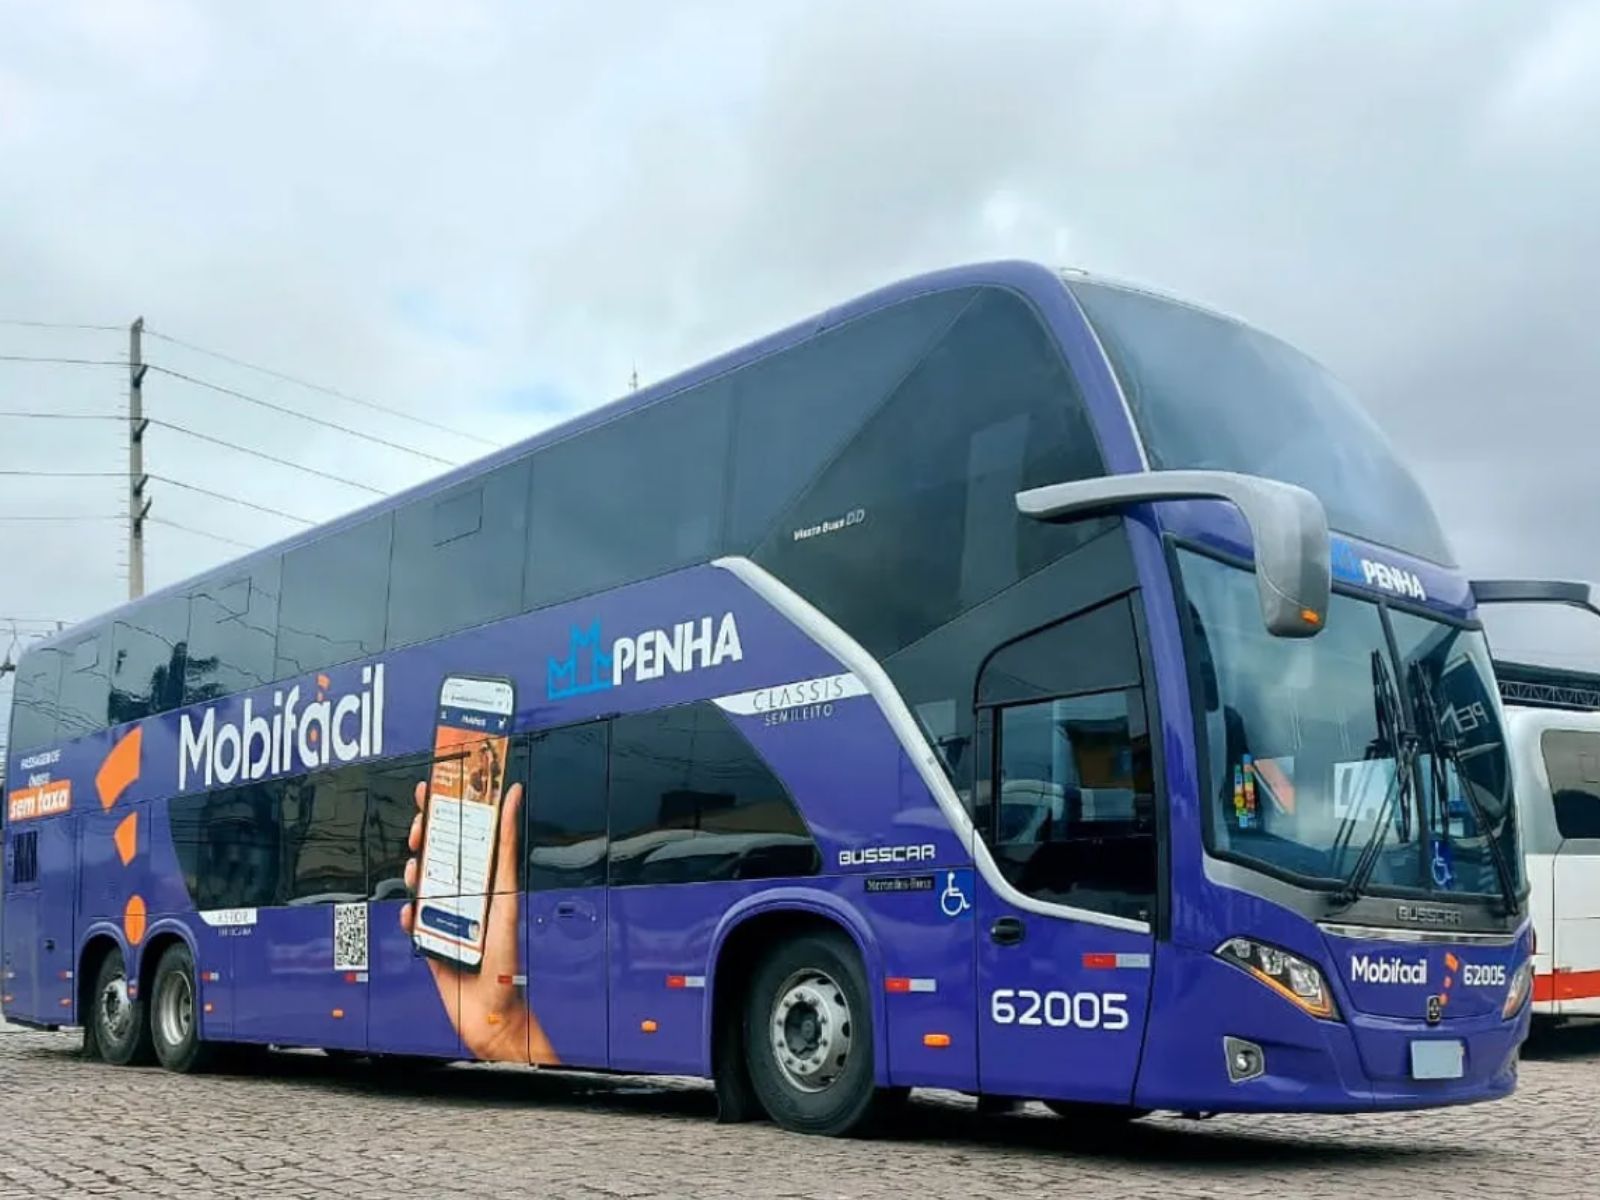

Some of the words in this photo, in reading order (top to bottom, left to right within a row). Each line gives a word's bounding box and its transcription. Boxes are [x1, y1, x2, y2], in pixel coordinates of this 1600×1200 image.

[1360, 559, 1427, 601] PENHA
[613, 612, 743, 686] PENHA
[753, 677, 844, 711] CLASSIS
[8, 796, 36, 820] sem
[37, 787, 70, 817] taxa
[839, 844, 936, 865] BUSSCAR
[1396, 905, 1462, 925] BUSSCAR
[1463, 965, 1506, 986] 62005
[991, 989, 1129, 1030] 62005
